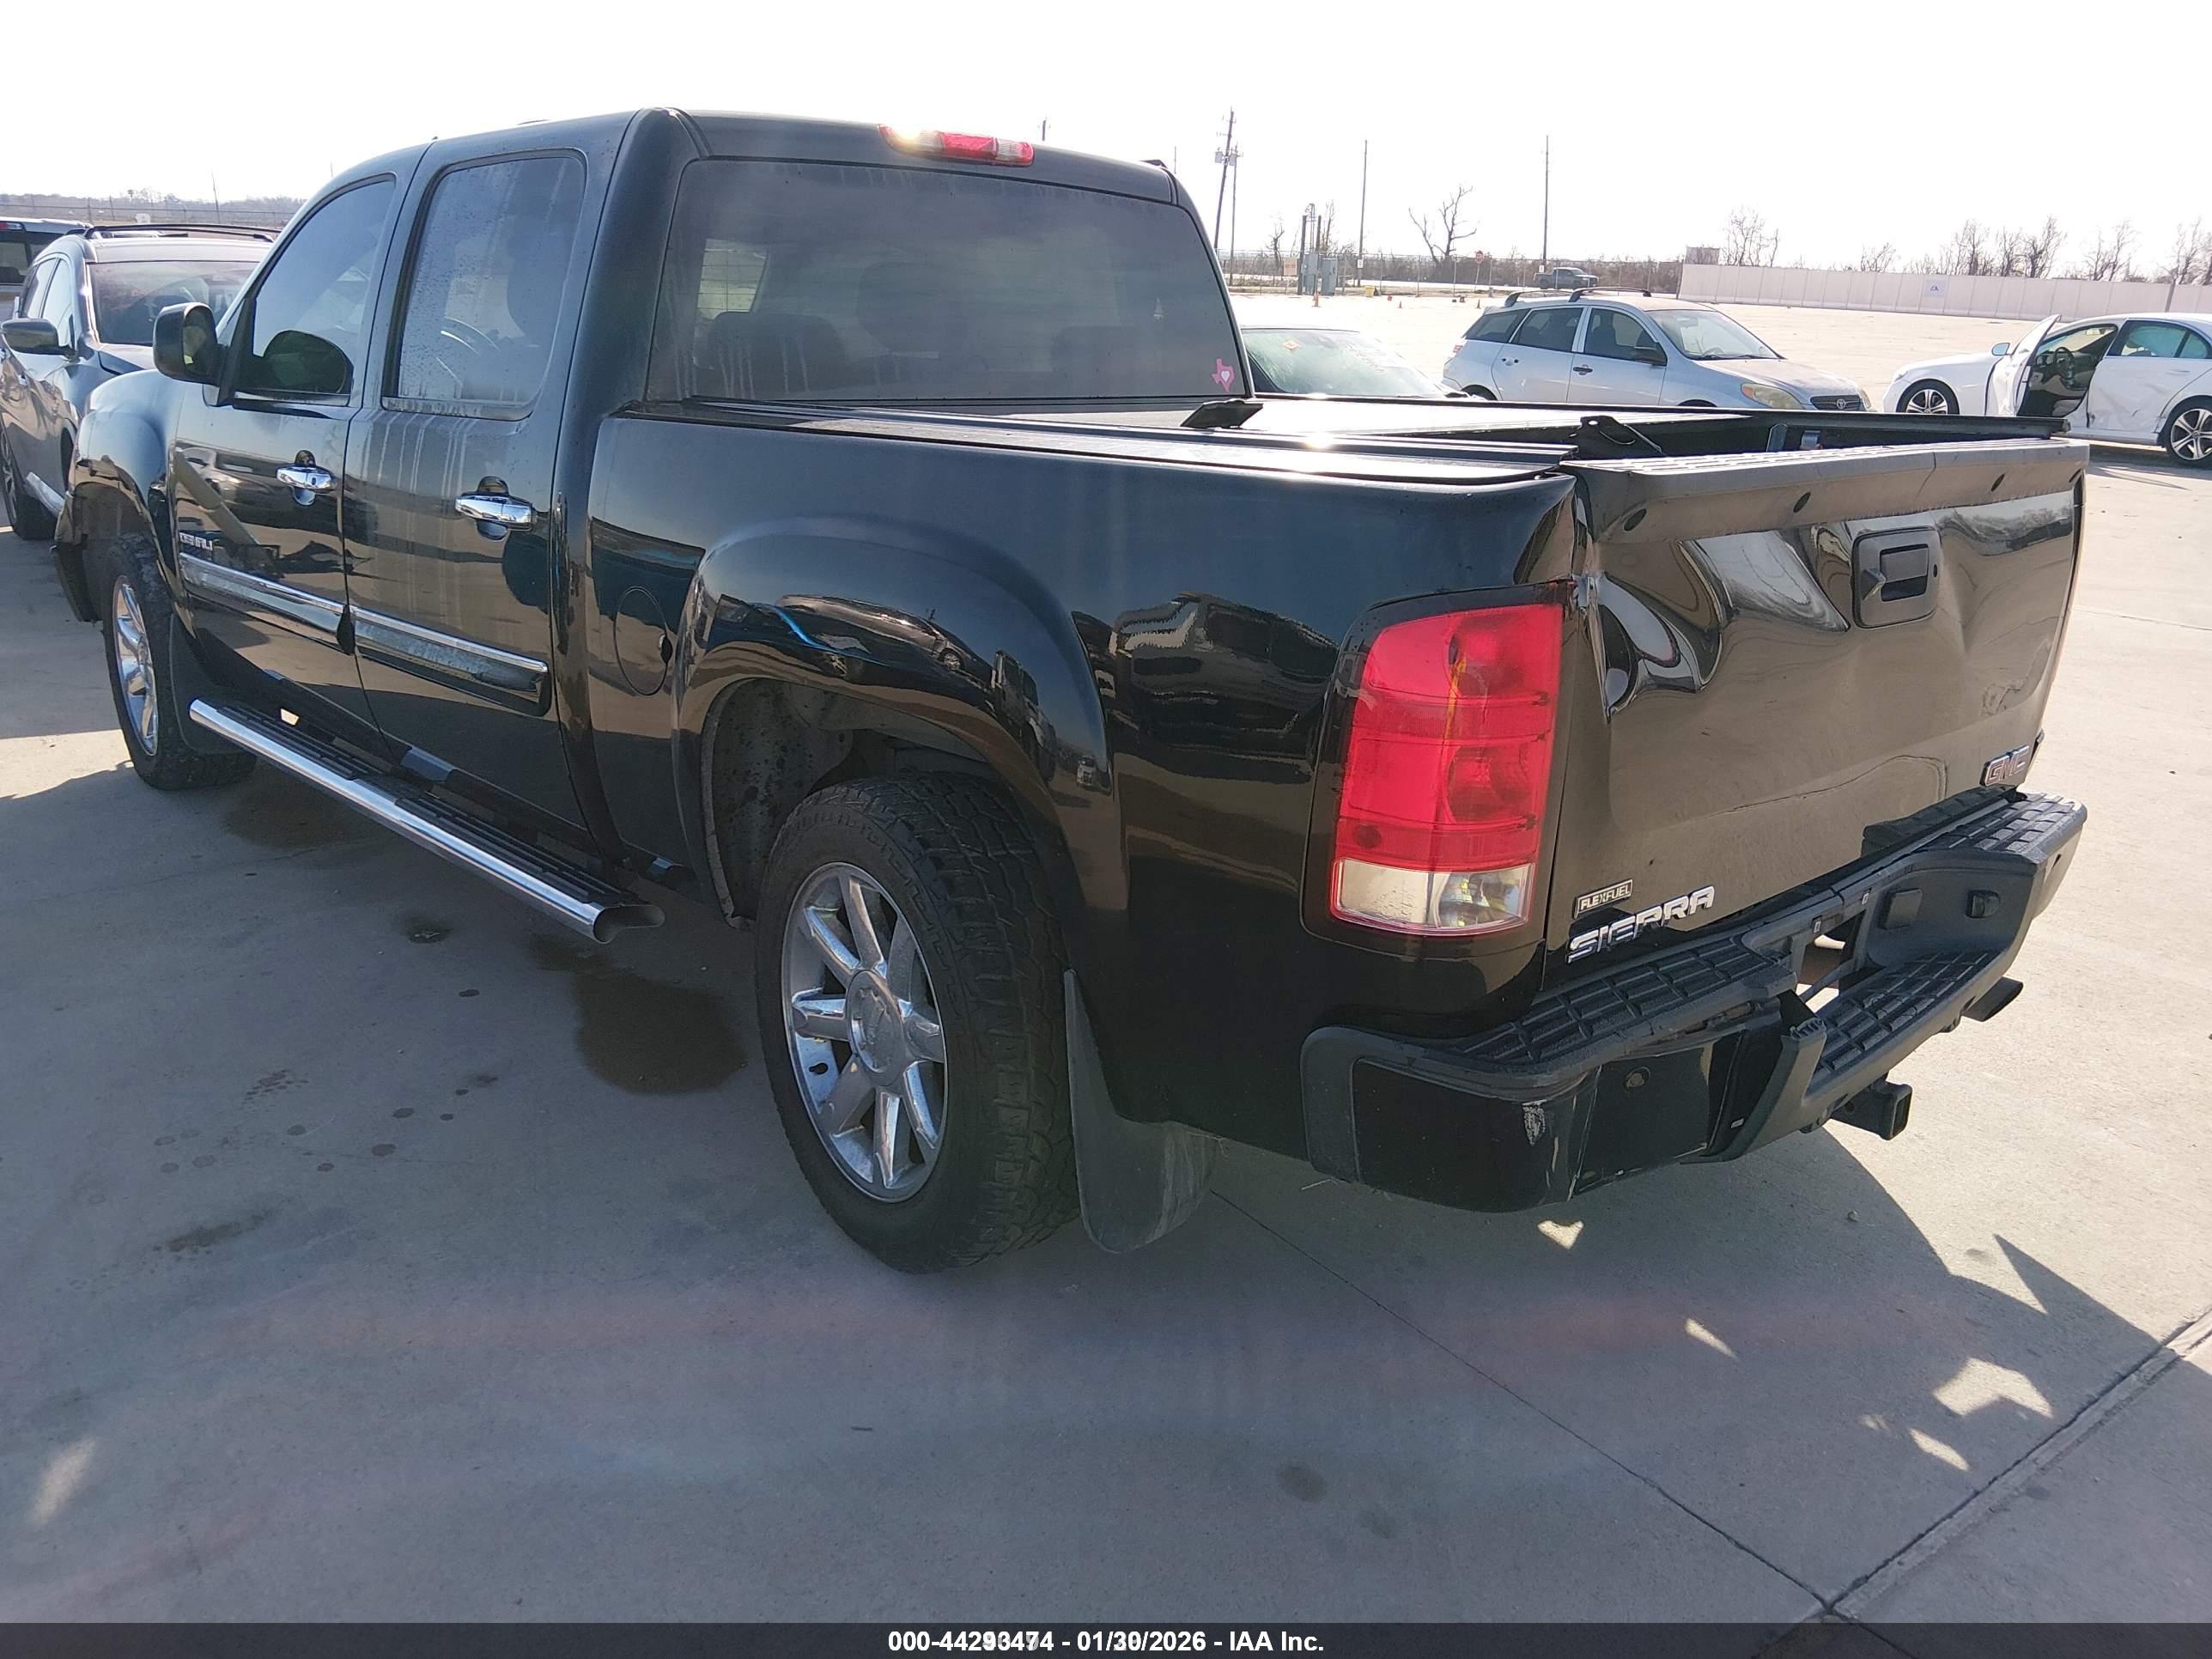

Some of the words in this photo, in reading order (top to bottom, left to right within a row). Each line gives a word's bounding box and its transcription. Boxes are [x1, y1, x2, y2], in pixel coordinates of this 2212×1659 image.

[1983, 744, 2030, 787] GMC
[1579, 884, 1632, 912] FLEXFUEL
[1566, 884, 1716, 964] SIERRA
